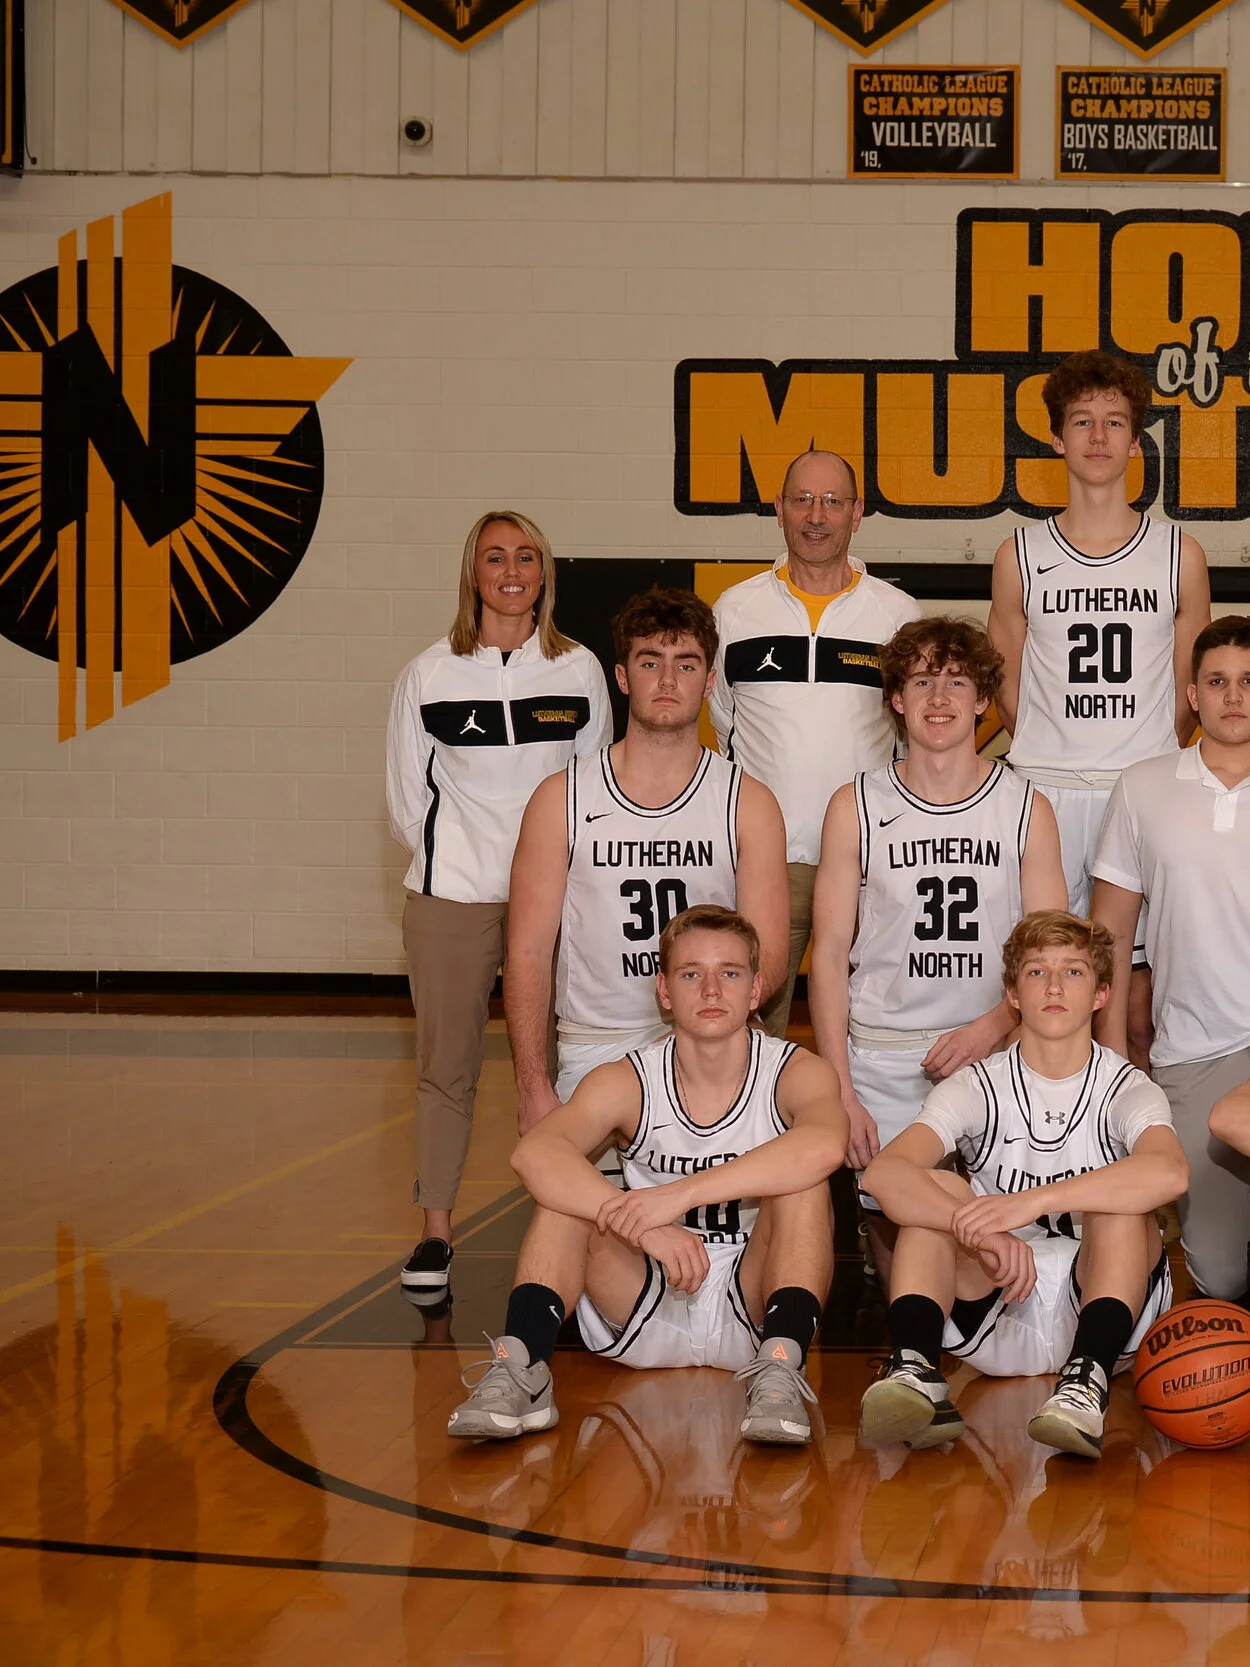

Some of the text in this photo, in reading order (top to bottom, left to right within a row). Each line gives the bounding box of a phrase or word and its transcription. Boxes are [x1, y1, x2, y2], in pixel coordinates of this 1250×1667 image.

[860, 74, 1008, 94] CATHOLIC LEAGUE
[1068, 76, 1215, 96] CATHOLIC LEAGUE
[863, 96, 1004, 117] CHAMPIONS
[1070, 99, 1211, 119] CHAMPIONS
[872, 121, 997, 148] VOLLEYBALL
[1064, 123, 1218, 151] BOYS BASKETBALL
[1157, 326, 1220, 403] of
[1042, 587, 1158, 613] LUTHERAN
[1067, 622, 1133, 684] 20
[1065, 693, 1136, 719] NORTH
[592, 840, 713, 867] LUTHERAN
[888, 838, 1000, 869] LUTHERAN
[620, 878, 689, 942] 30
[915, 876, 979, 942] 32
[622, 951, 660, 977] NOR
[909, 952, 983, 979] NORTH
[1146, 1315, 1246, 1357] Wilson
